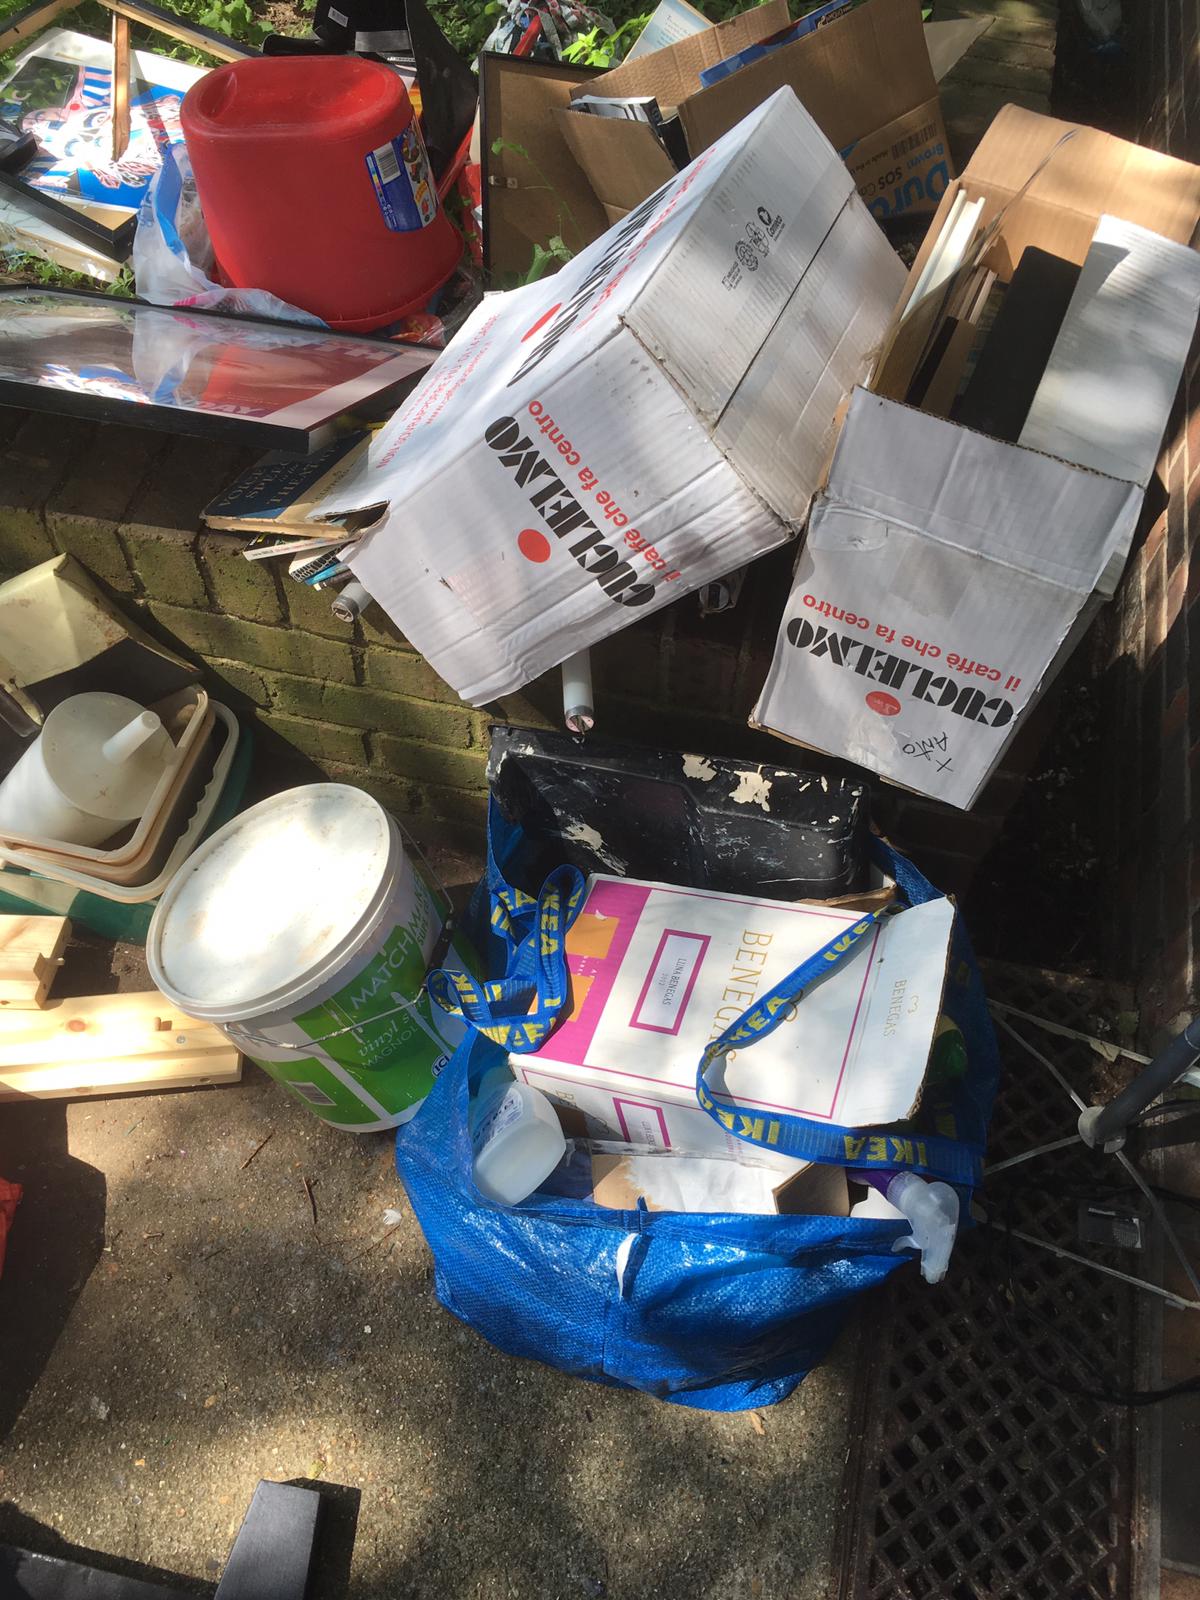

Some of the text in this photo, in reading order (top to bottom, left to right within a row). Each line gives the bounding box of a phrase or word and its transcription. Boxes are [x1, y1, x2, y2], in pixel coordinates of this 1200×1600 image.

[878, 167, 903, 190] SOS
[528, 400, 581, 466] centro
[577, 466, 600, 491] fa
[485, 416, 656, 607] GUGLIELMO
[595, 490, 629, 527] che
[802, 594, 1022, 692] il caffè che fa centro
[786, 617, 1014, 728] GUGLIELMO
[843, 1135, 929, 1167] IKEA
